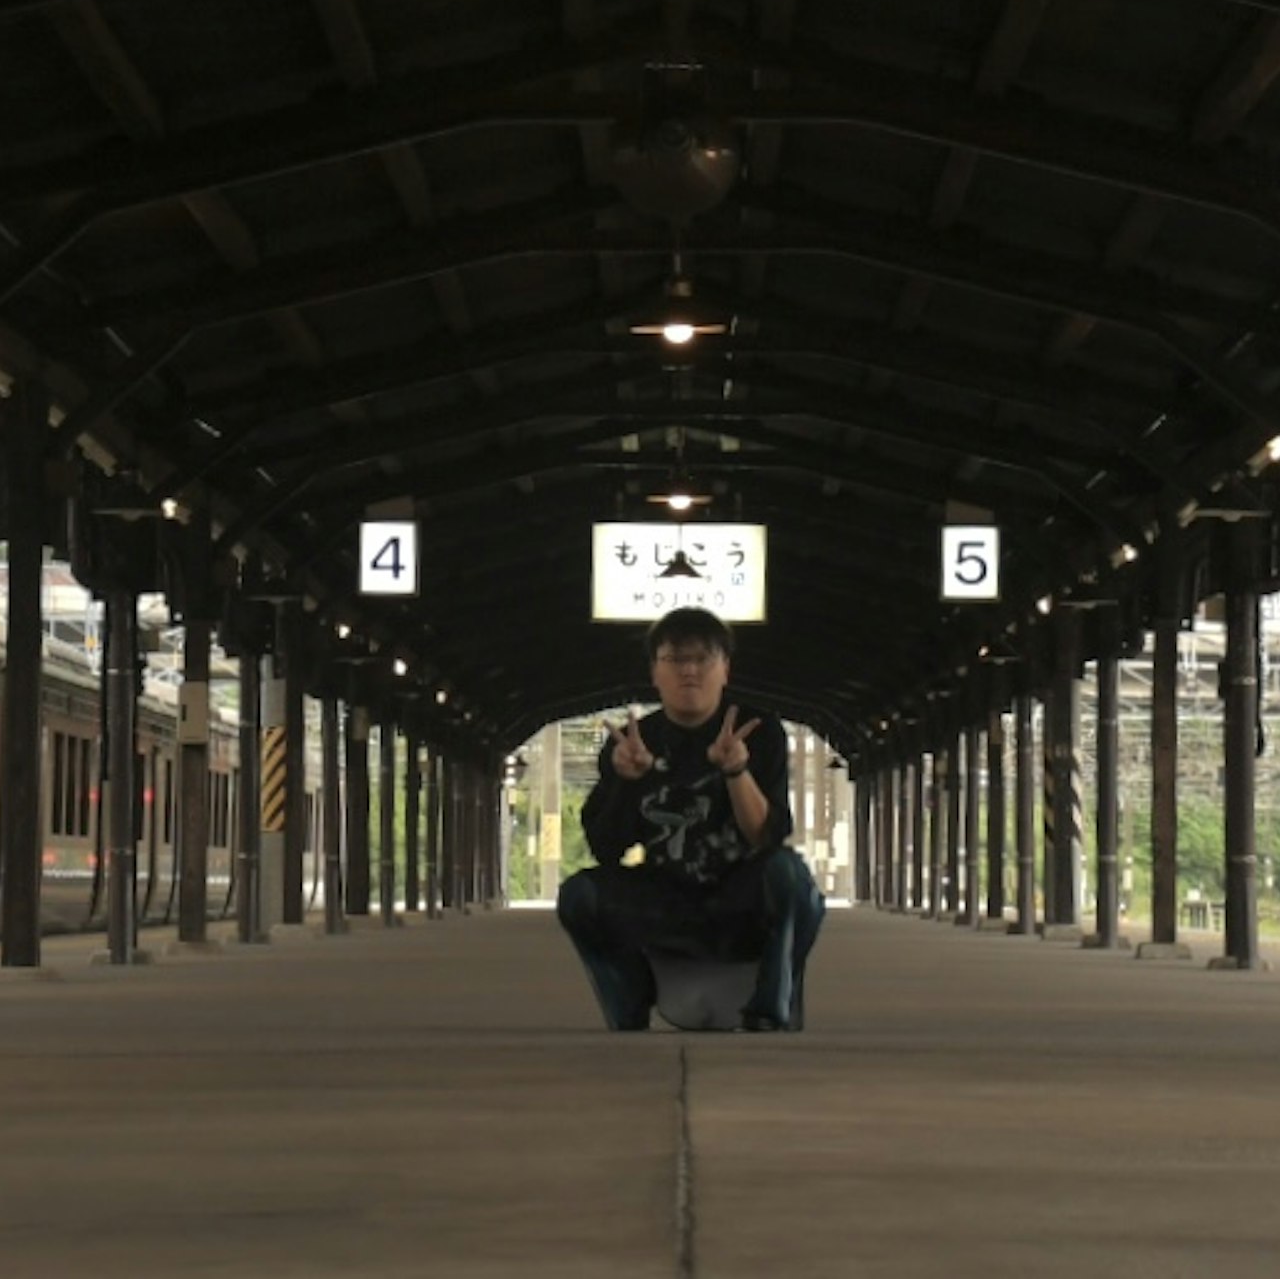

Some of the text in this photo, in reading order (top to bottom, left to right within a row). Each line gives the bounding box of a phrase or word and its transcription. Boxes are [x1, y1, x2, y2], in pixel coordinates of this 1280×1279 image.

[370, 536, 405, 580] 4
[614, 541, 745, 568] もじこう
[955, 541, 987, 585] 5
